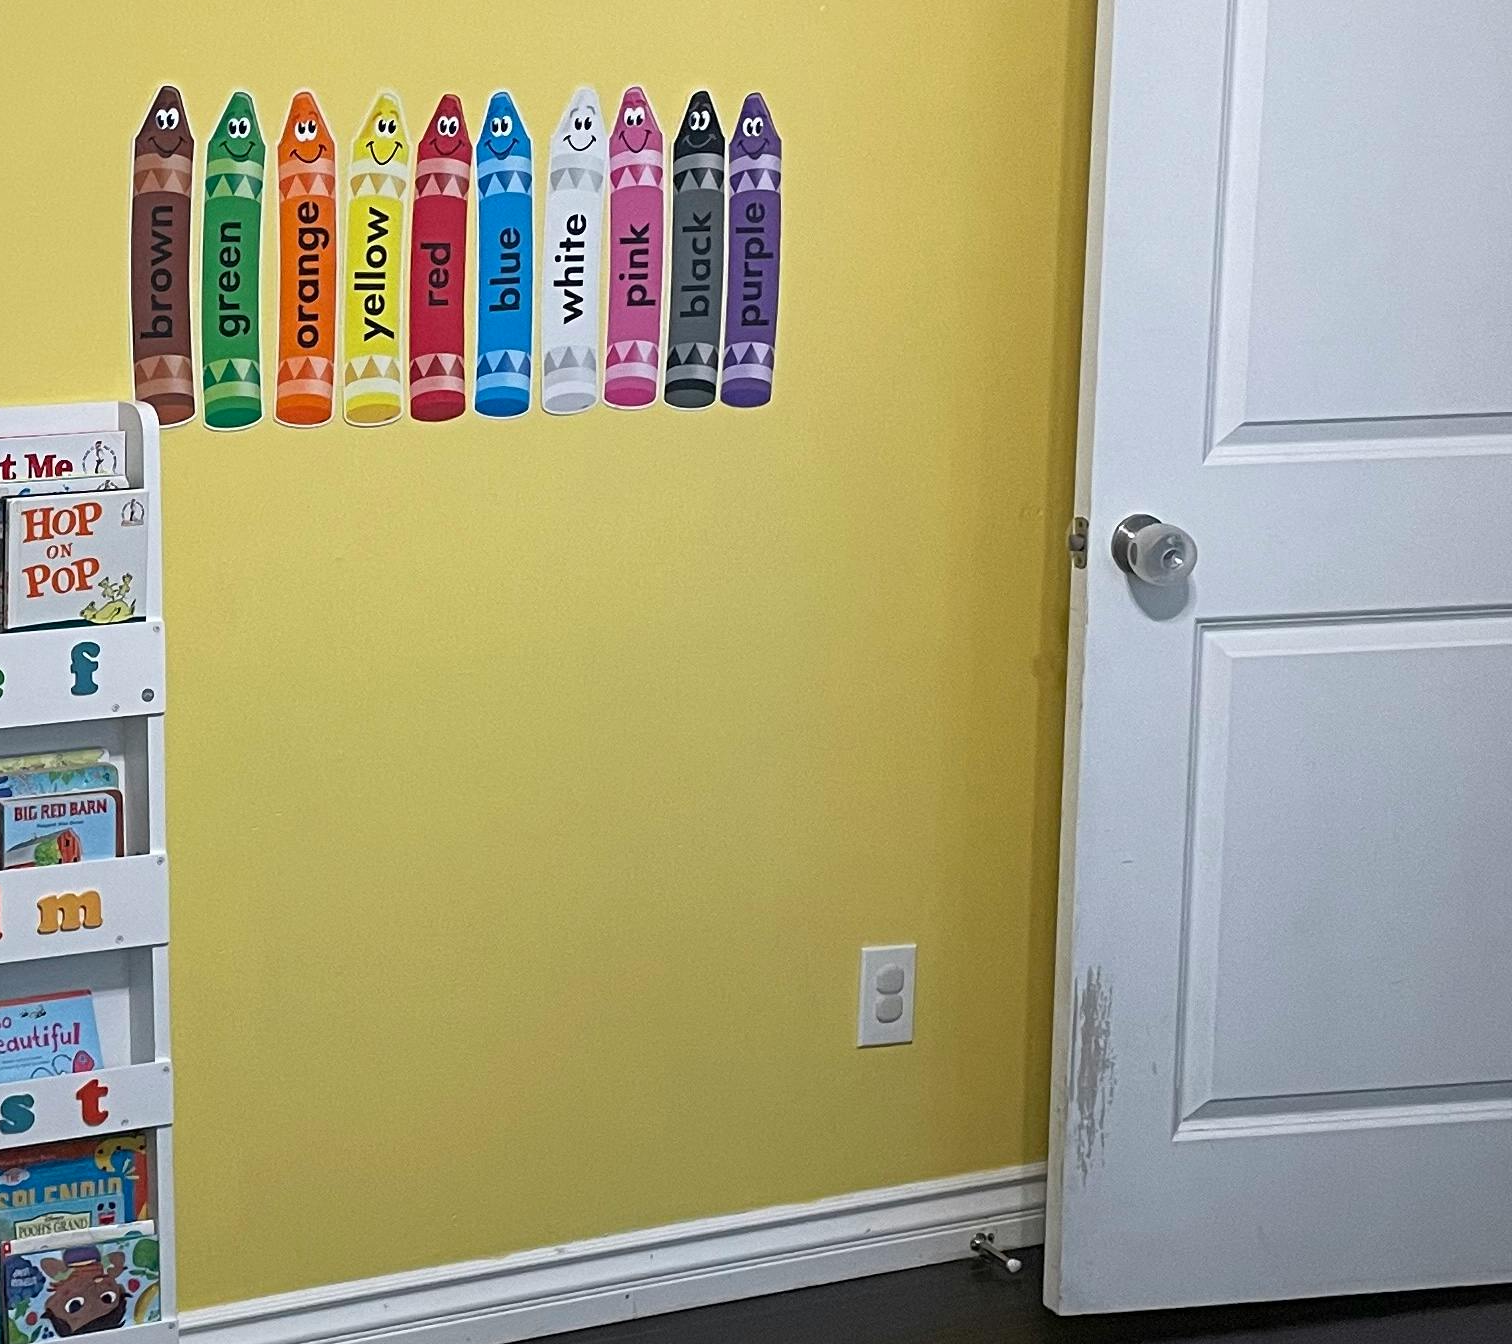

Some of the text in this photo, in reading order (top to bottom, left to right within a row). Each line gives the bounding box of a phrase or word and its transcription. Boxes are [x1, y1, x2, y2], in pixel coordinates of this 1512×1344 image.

[141, 204, 174, 340] brown
[219, 221, 251, 339] green
[295, 199, 330, 350] orange
[364, 206, 396, 342] yellow
[426, 240, 452, 307] red
[489, 225, 522, 313] blue
[553, 212, 588, 325] white
[618, 221, 651, 308] pink
[679, 210, 713, 320] black
[740, 201, 775, 327] purple
[24, 453, 73, 479] Me
[22, 502, 103, 543] HOP
[46, 543, 73, 559] ON
[22, 557, 100, 598] POP
[70, 641, 101, 696] f
[69, 798, 107, 816] BARN
[37, 890, 103, 935] m
[0, 1093, 35, 1135] s
[75, 1079, 109, 1126] t
